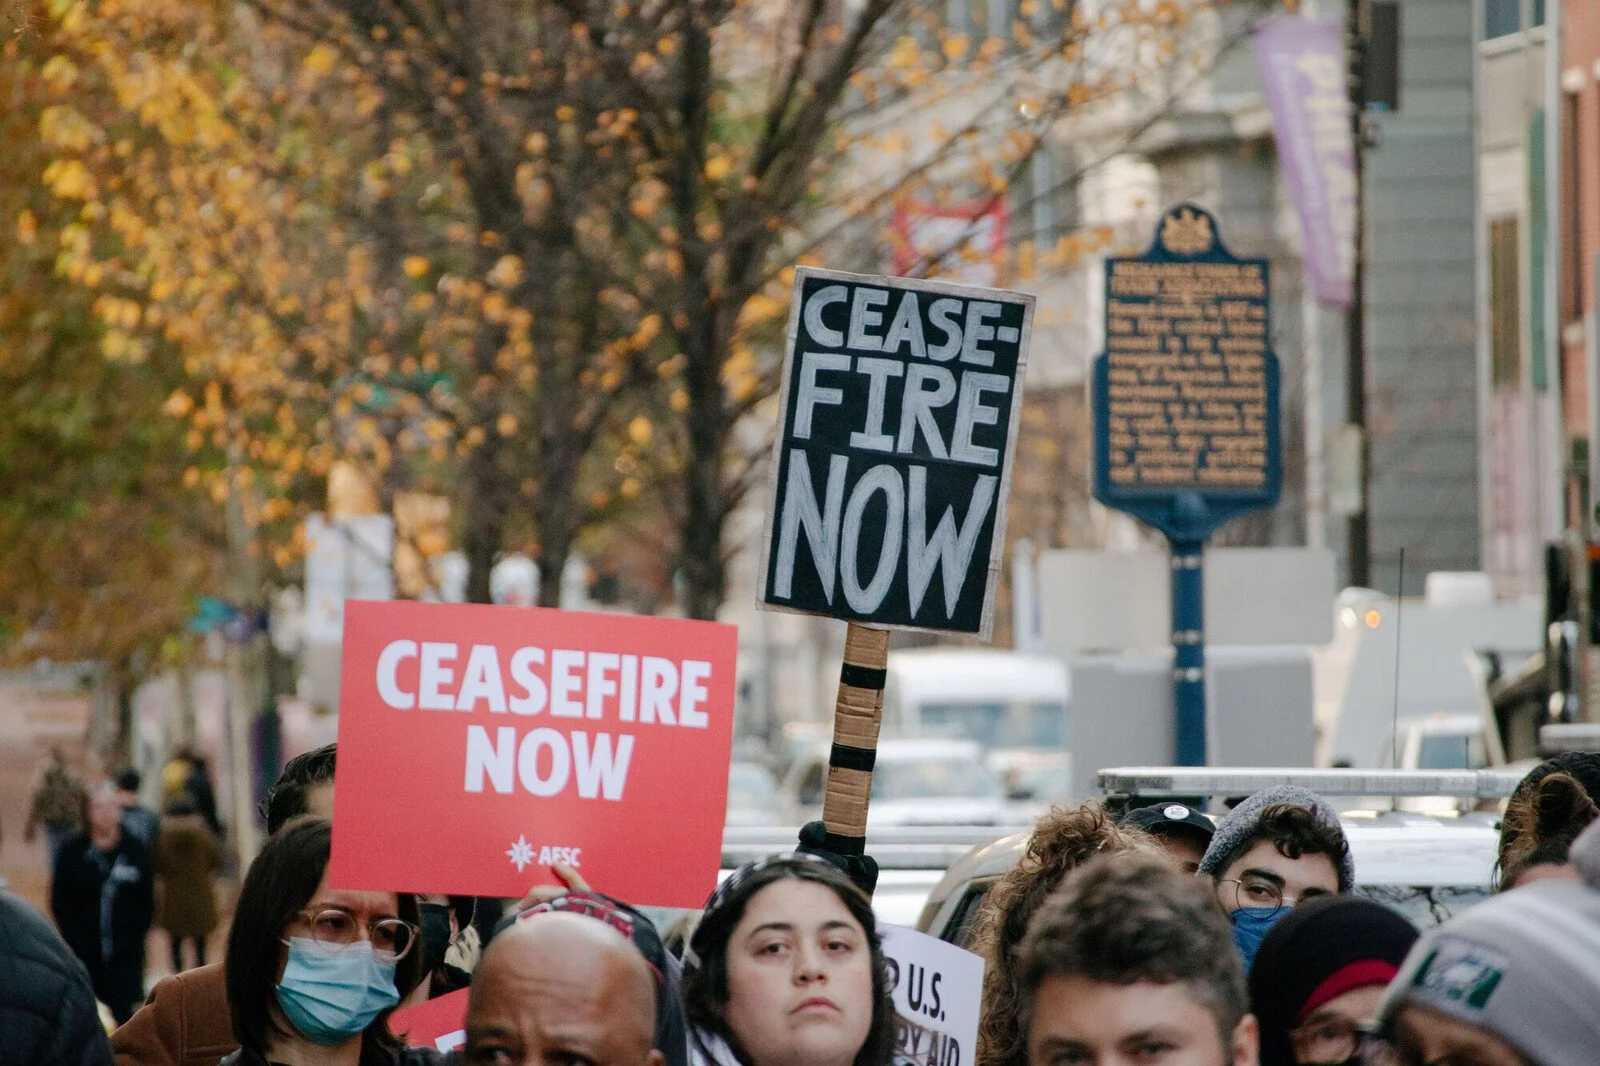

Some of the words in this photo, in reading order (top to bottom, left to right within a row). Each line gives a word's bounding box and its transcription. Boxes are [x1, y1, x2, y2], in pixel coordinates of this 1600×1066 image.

[803, 285, 1019, 367] CEASE-
[793, 352, 1010, 466] FIRE
[774, 449, 999, 619] NOW
[376, 640, 712, 728] CEASEFIRE
[464, 725, 635, 801] NOW
[908, 963, 945, 1022] U.S.
